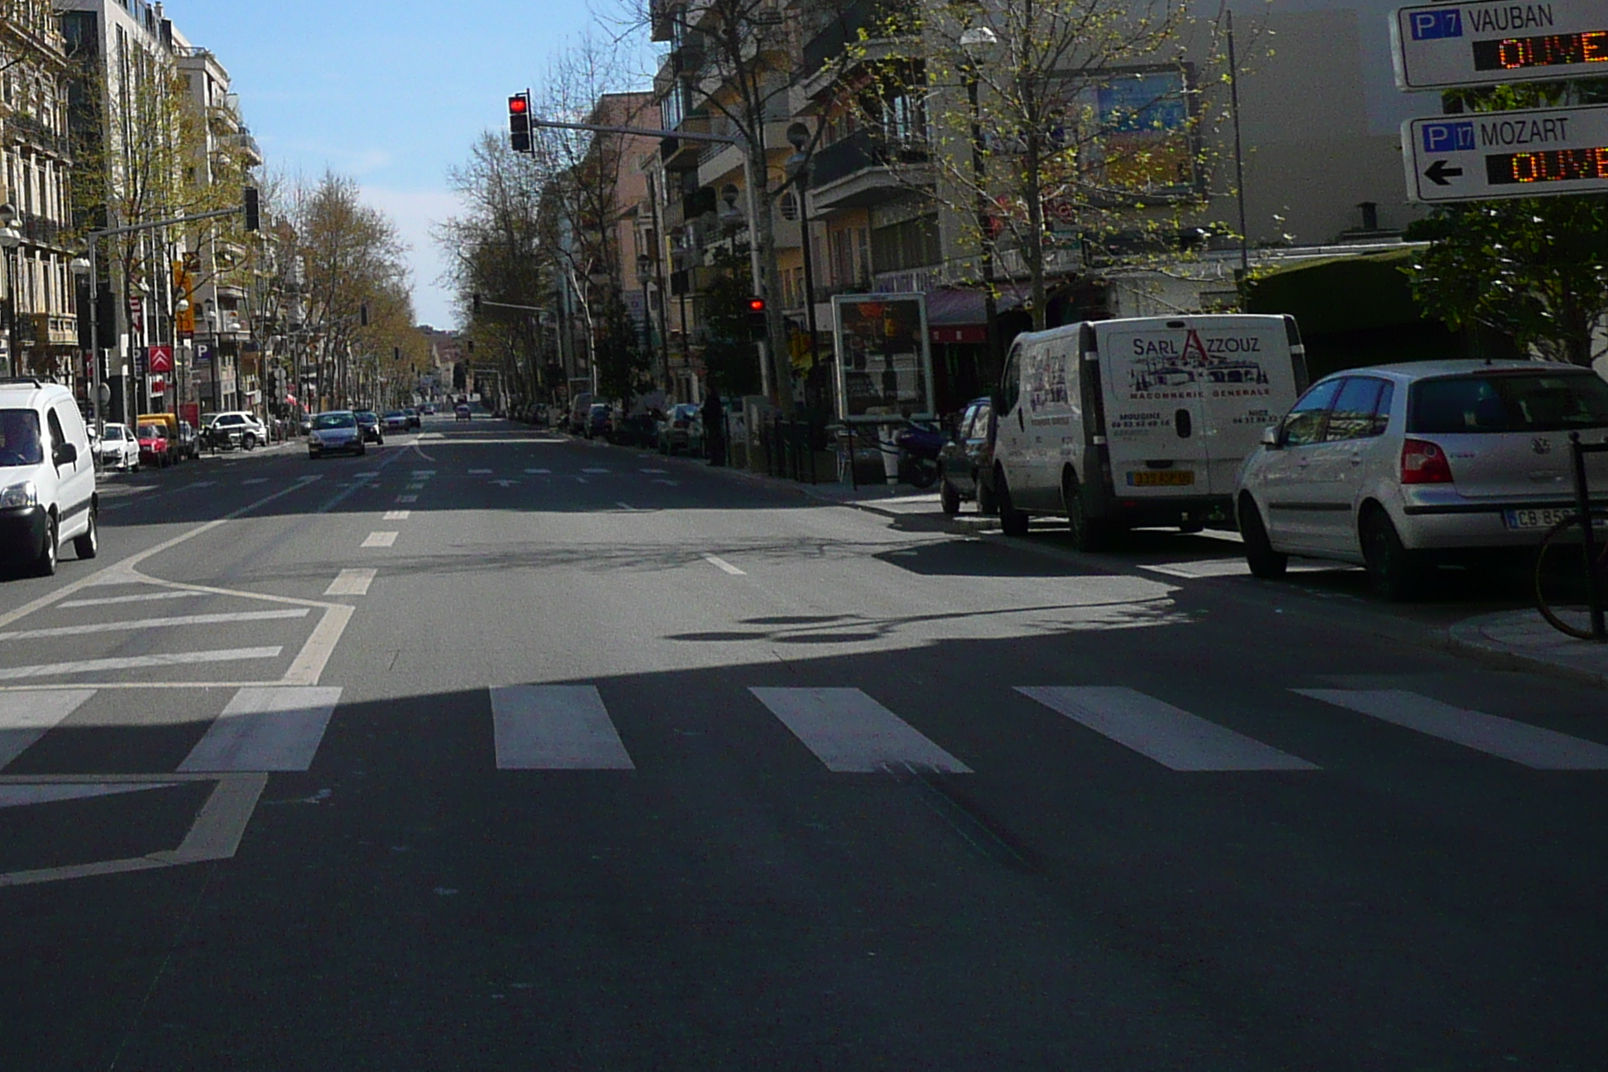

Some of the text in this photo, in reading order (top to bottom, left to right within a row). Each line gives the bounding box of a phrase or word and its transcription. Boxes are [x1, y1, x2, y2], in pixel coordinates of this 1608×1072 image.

[1416, 4, 1554, 37] P 7 VAUBAN
[1499, 31, 1608, 69] OUVE
[1428, 118, 1568, 149] P 17 MOZART
[198, 345, 208, 358] P
[1133, 329, 1260, 360] SARL AZZOUZ
[1130, 389, 1270, 399] MACONNERIE GENERALE
[1518, 510, 1538, 526] CB
